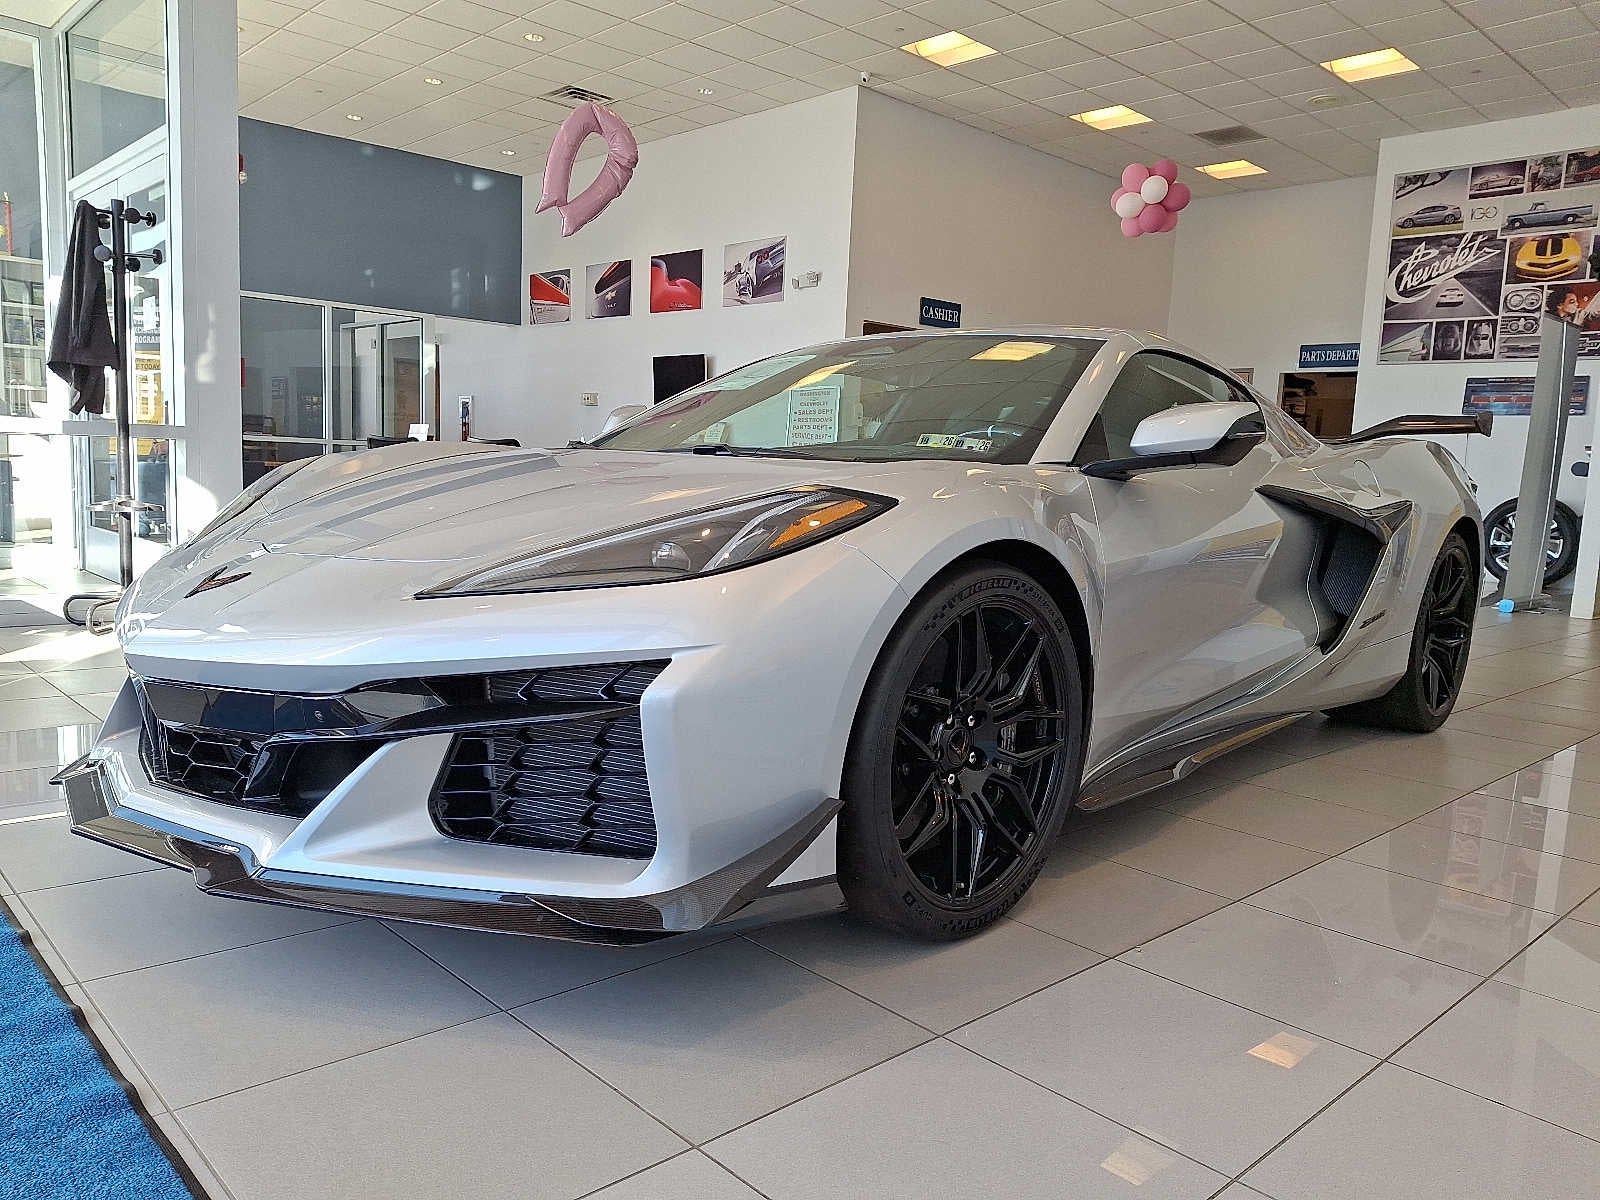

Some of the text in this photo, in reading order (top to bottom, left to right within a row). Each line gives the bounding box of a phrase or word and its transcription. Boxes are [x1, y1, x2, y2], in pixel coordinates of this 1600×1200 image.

[1386, 232, 1501, 303] Chevrolet
[922, 305, 959, 322] CASHIER
[1301, 350, 1326, 362] PARTS
